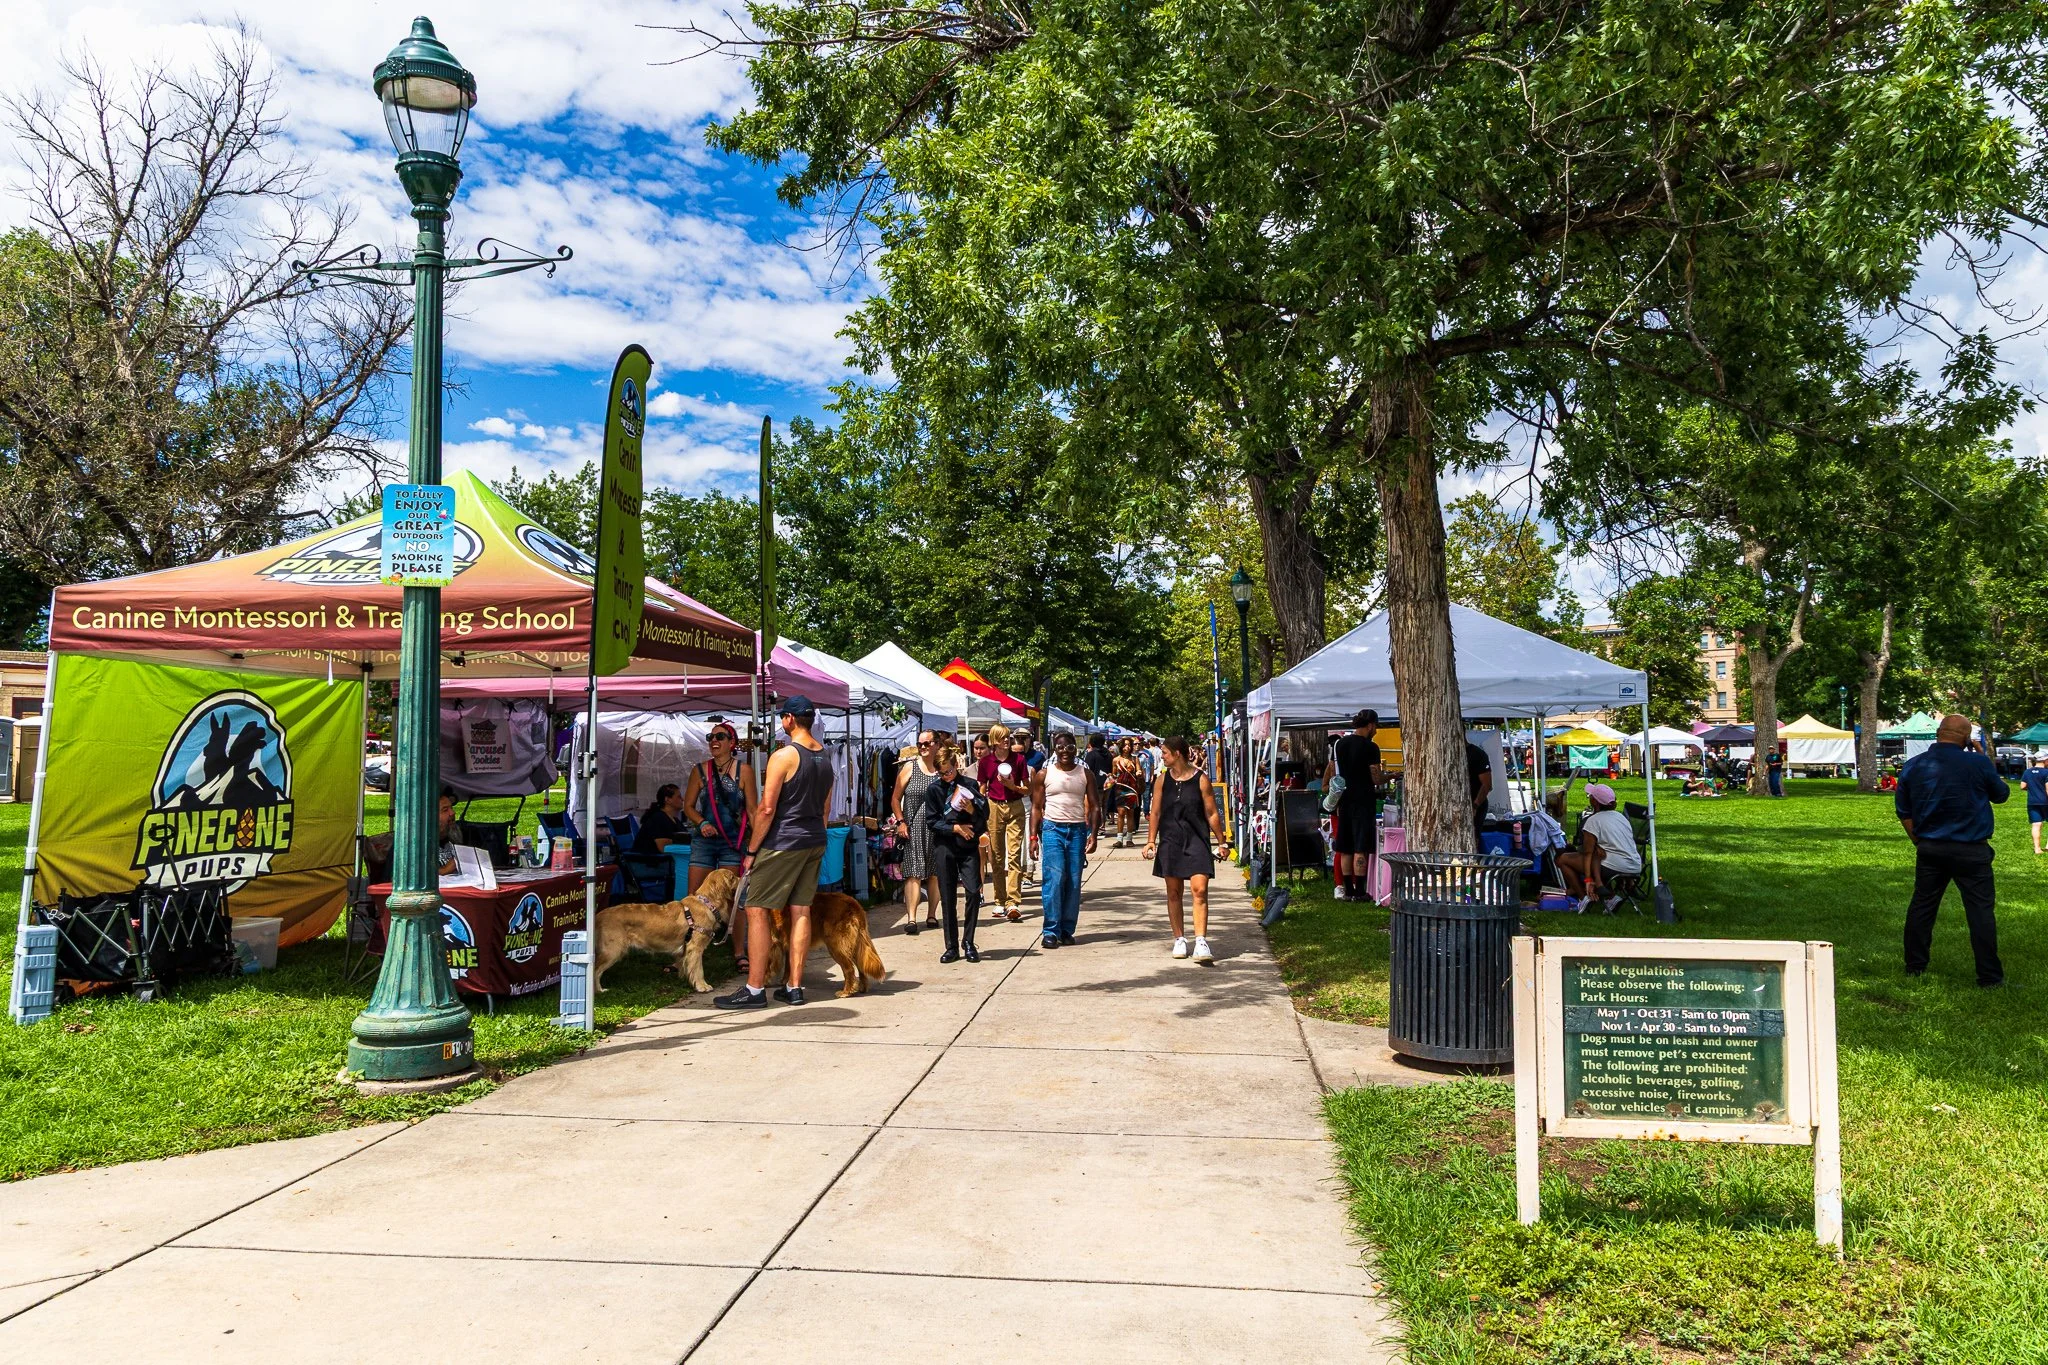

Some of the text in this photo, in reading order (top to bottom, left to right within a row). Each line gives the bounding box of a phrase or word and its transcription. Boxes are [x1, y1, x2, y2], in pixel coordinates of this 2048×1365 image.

[396, 490, 443, 499] TO FULLY
[395, 500, 443, 511] ENJOY
[394, 521, 443, 531] GREAT
[392, 532, 443, 540] OUTDOORS
[405, 541, 430, 552] NO
[391, 553, 443, 562] SMOKING
[392, 563, 442, 573] PLEASE
[72, 604, 576, 636] Canine Montessori & Trang School
[642, 619, 694, 646] Montessori
[694, 629, 701, 648] &
[703, 631, 731, 659] Training
[731, 638, 754, 659] School
[467, 743, 507, 754] arousel
[182, 857, 246, 882] PUPS
[545, 893, 569, 909] Canine
[553, 913, 579, 928] Training
[1580, 965, 1685, 977] Park Regulations
[1580, 979, 1745, 993] Please observe the following:
[1580, 993, 1648, 1003] Park Hours:
[1597, 1009, 1620, 1018] May
[1622, 1009, 1627, 1018] 1
[1637, 1009, 1658, 1018] Oct
[1660, 1009, 1672, 1018] 31
[1681, 1010, 1705, 1019] 5am
[1707, 1010, 1719, 1019] to
[1721, 1011, 1750, 1021] 10pm
[1601, 1021, 1625, 1031] Nov
[1626, 1021, 1631, 1030] 1
[1641, 1022, 1662, 1034] Apr
[1663, 1023, 1675, 1032] 30
[1685, 1023, 1708, 1032] 5am
[1710, 1023, 1721, 1033] to
[1723, 1023, 1746, 1034] 9pm
[1581, 1034, 1607, 1045] Dogs
[1610, 1035, 1635, 1044] must
[1639, 1036, 1652, 1045] be
[1673, 1036, 1699, 1046] leash
[1703, 1037, 1722, 1046] and
[1725, 1039, 1758, 1047] owner
[1581, 1049, 1608, 1057] must
[1659, 1050, 1687, 1060] pet's
[1691, 1051, 1755, 1061] excrement.
[1582, 1061, 1748, 1075] The following are prohibited:
[1582, 1075, 1744, 1089] alcoholic beverages, golfing,
[1582, 1089, 1735, 1102] excessive noise, fireworks,
[1621, 1104, 1665, 1112] vehicles
